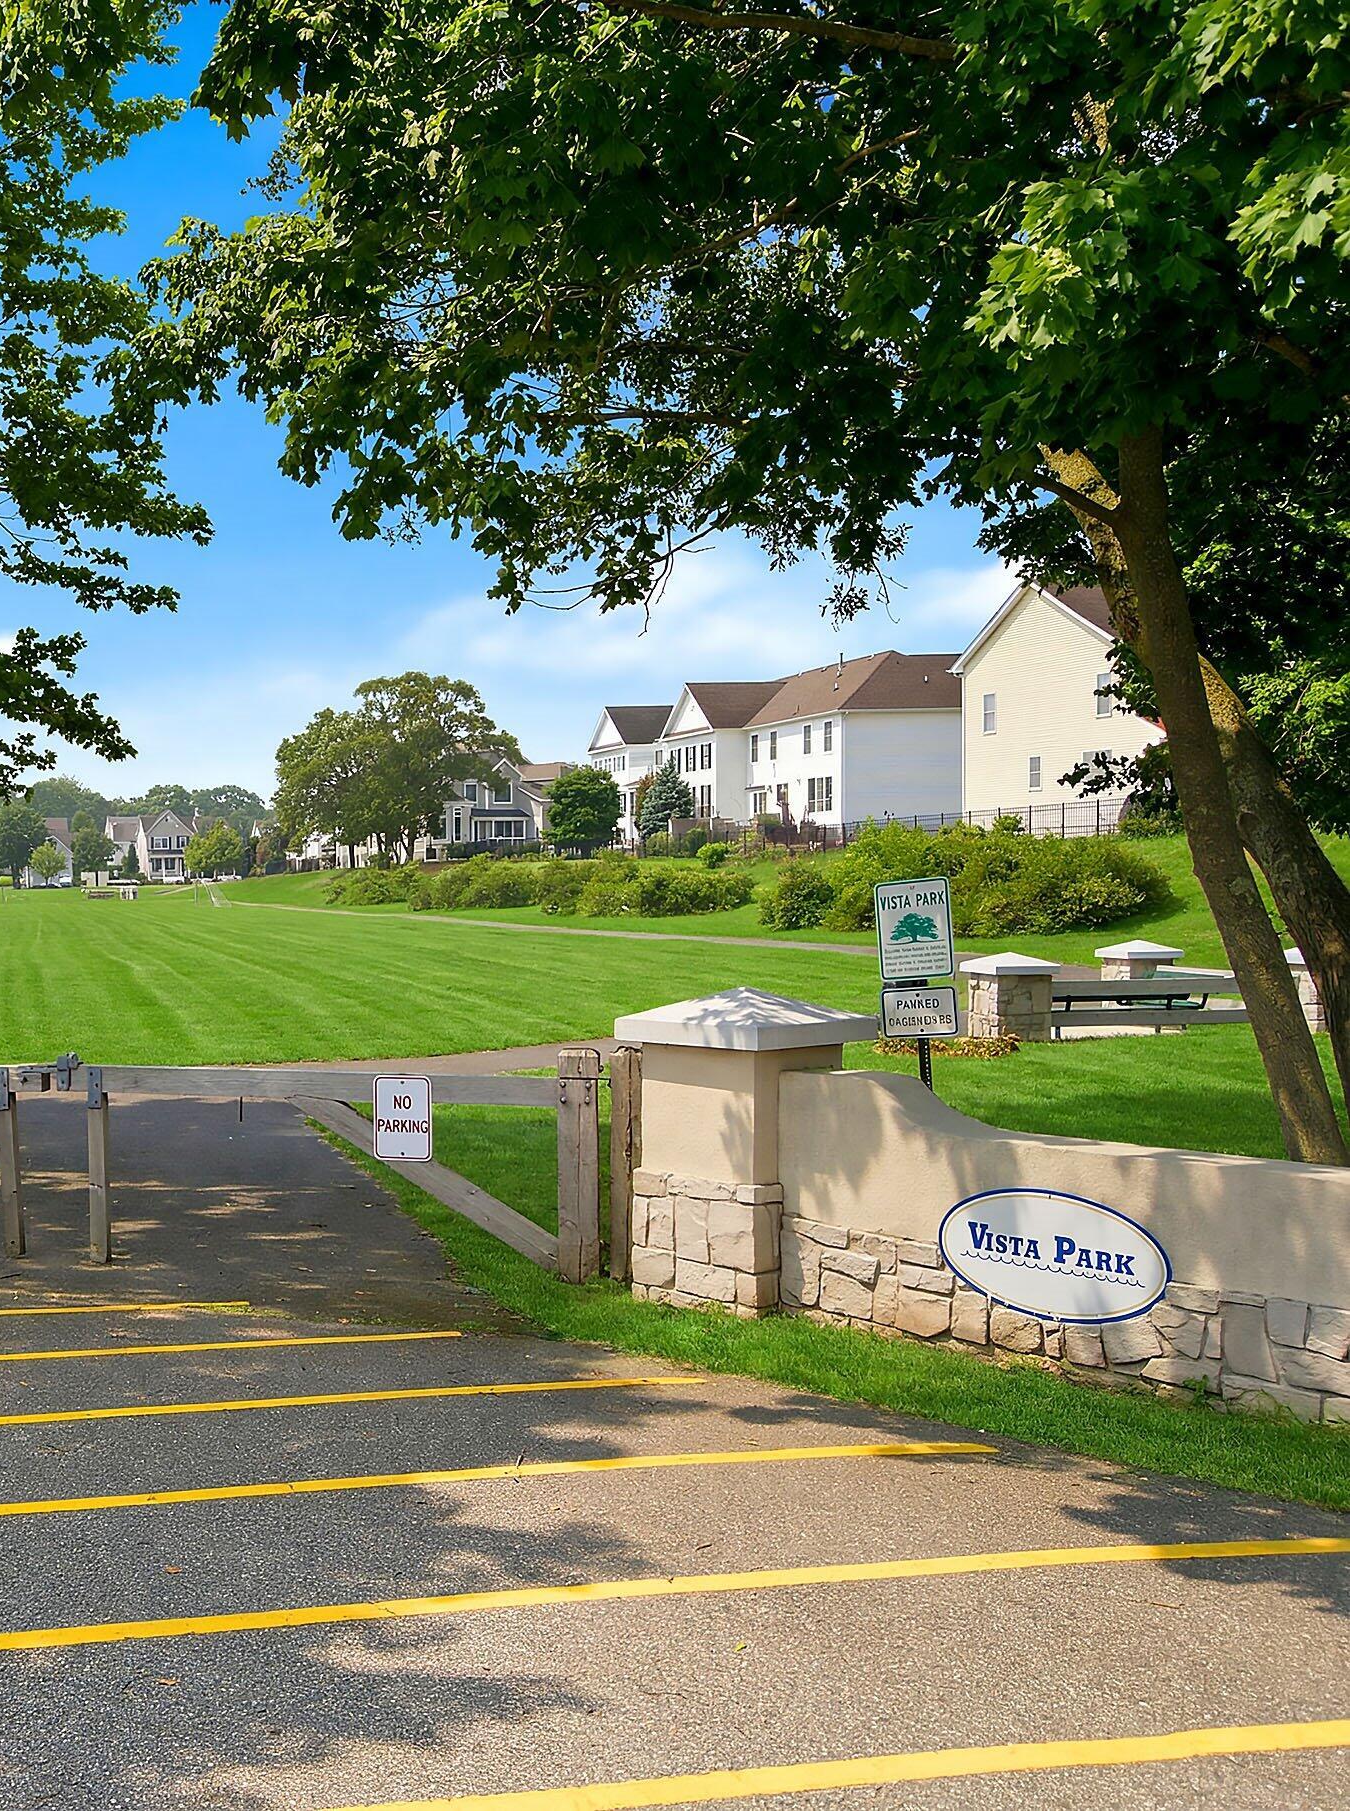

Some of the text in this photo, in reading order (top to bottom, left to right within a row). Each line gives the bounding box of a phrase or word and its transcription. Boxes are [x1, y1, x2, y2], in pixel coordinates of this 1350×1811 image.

[880, 894, 912, 911] VISTA
[393, 1095, 412, 1110] NO
[377, 1119, 429, 1134] PARKING
